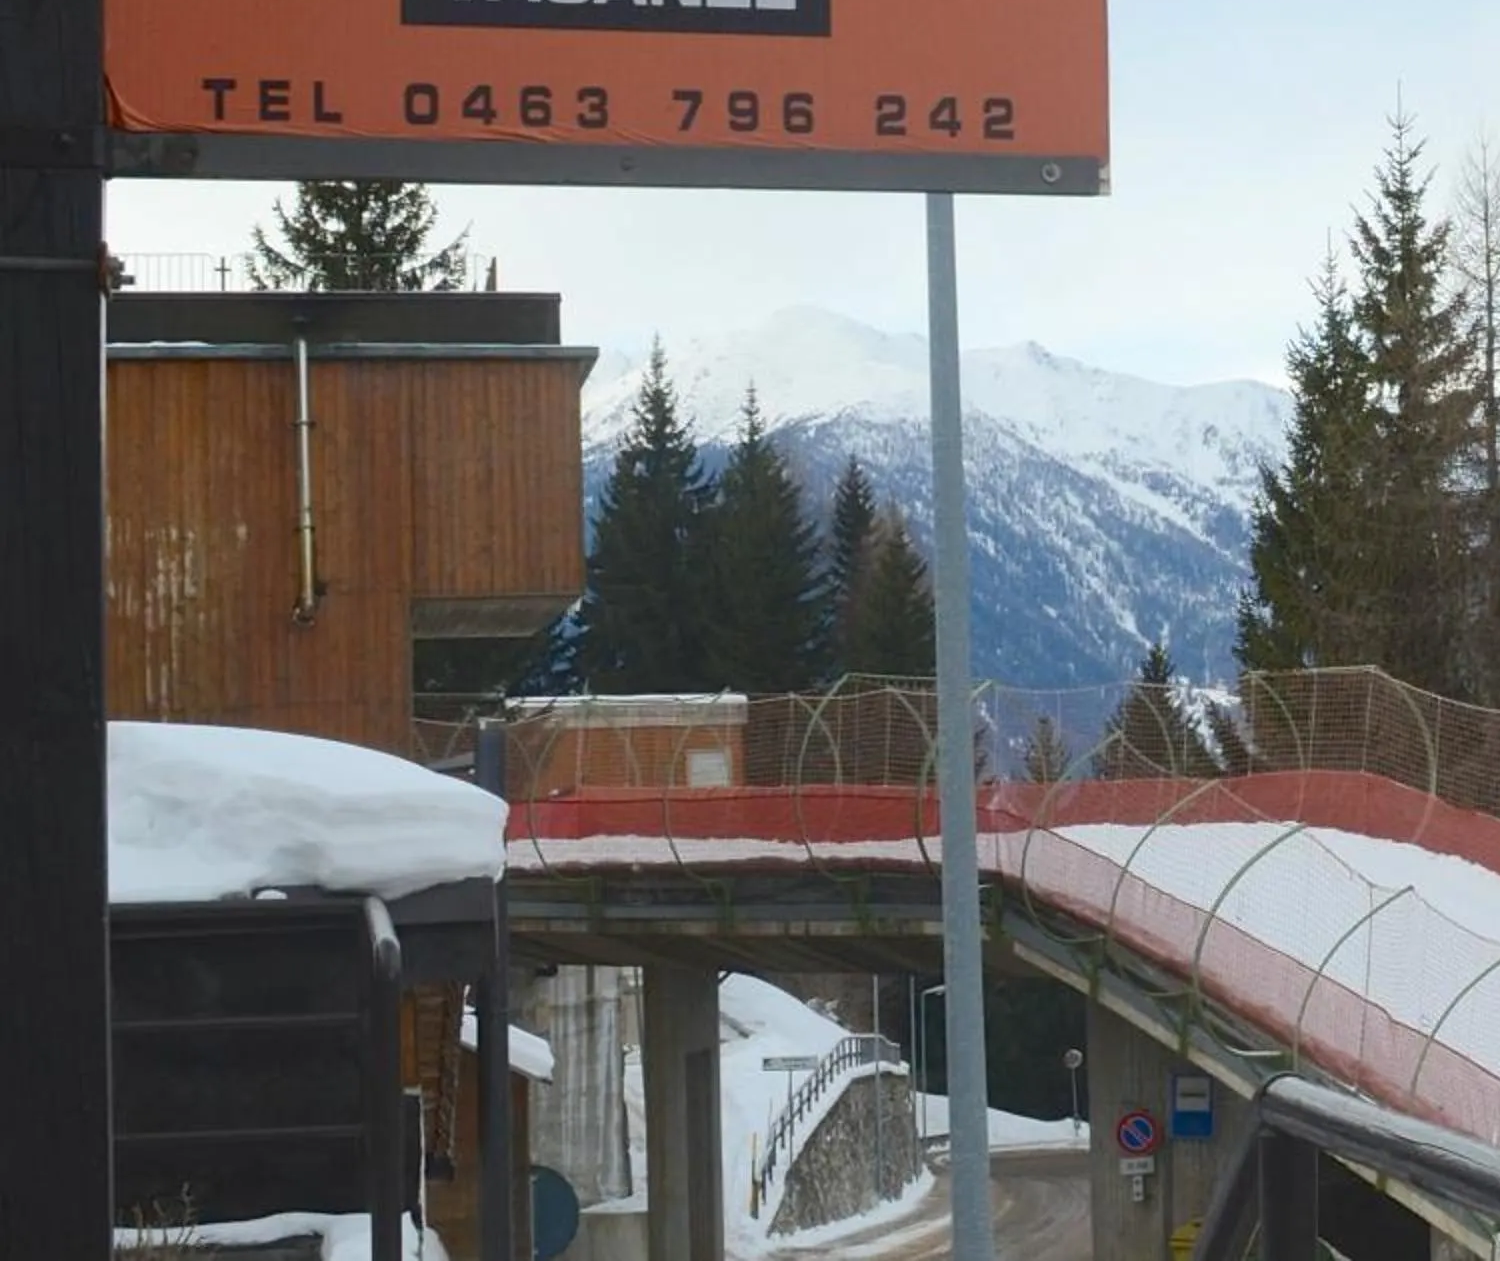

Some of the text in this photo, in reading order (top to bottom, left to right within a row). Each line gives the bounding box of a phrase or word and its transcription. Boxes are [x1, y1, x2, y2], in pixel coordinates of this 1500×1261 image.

[200, 77, 1015, 140] TEL 0463 796 242
